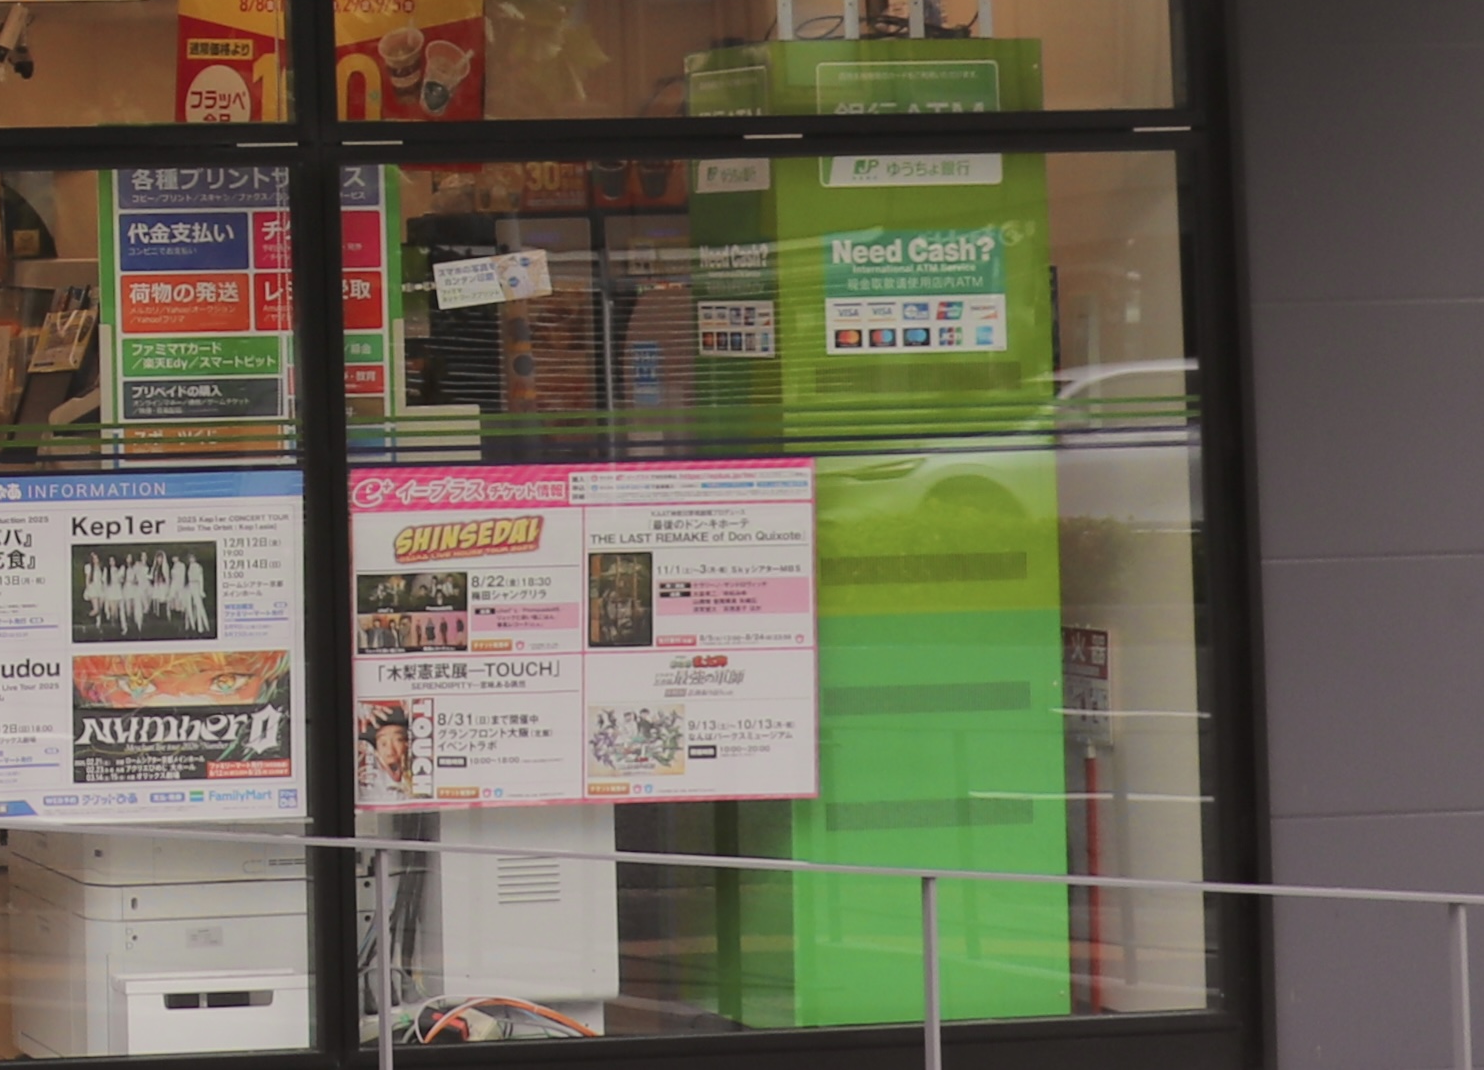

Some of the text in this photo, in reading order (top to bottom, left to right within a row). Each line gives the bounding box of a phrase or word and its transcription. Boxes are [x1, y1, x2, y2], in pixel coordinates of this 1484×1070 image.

[189, 42, 250, 57] 通常価格より
[190, 90, 246, 110] フラッペ
[886, 159, 971, 178] ゆうちょ銀行
[127, 222, 235, 244] 代金支払い
[832, 236, 996, 264] Need Cash?
[852, 264, 913, 274] International
[915, 264, 938, 273] ATM
[129, 281, 240, 304] 荷物の発送
[131, 343, 222, 354] ファミマTカード
[131, 385, 223, 397] プリペイドの購入
[28, 481, 167, 500] INFORMATION
[396, 476, 485, 504] イープラス
[488, 482, 566, 501] チケット情報
[71, 516, 166, 539] Kep1er
[396, 517, 541, 556] SHINSEDAI
[590, 533, 616, 544] THE
[619, 533, 651, 544] LAST
[655, 532, 709, 543] REMAKE
[712, 532, 725, 541] of
[728, 532, 753, 542] Don
[222, 549, 244, 557] 19:00
[437, 741, 497, 751] イベントラボ
[208, 790, 272, 802] FamilyMart
